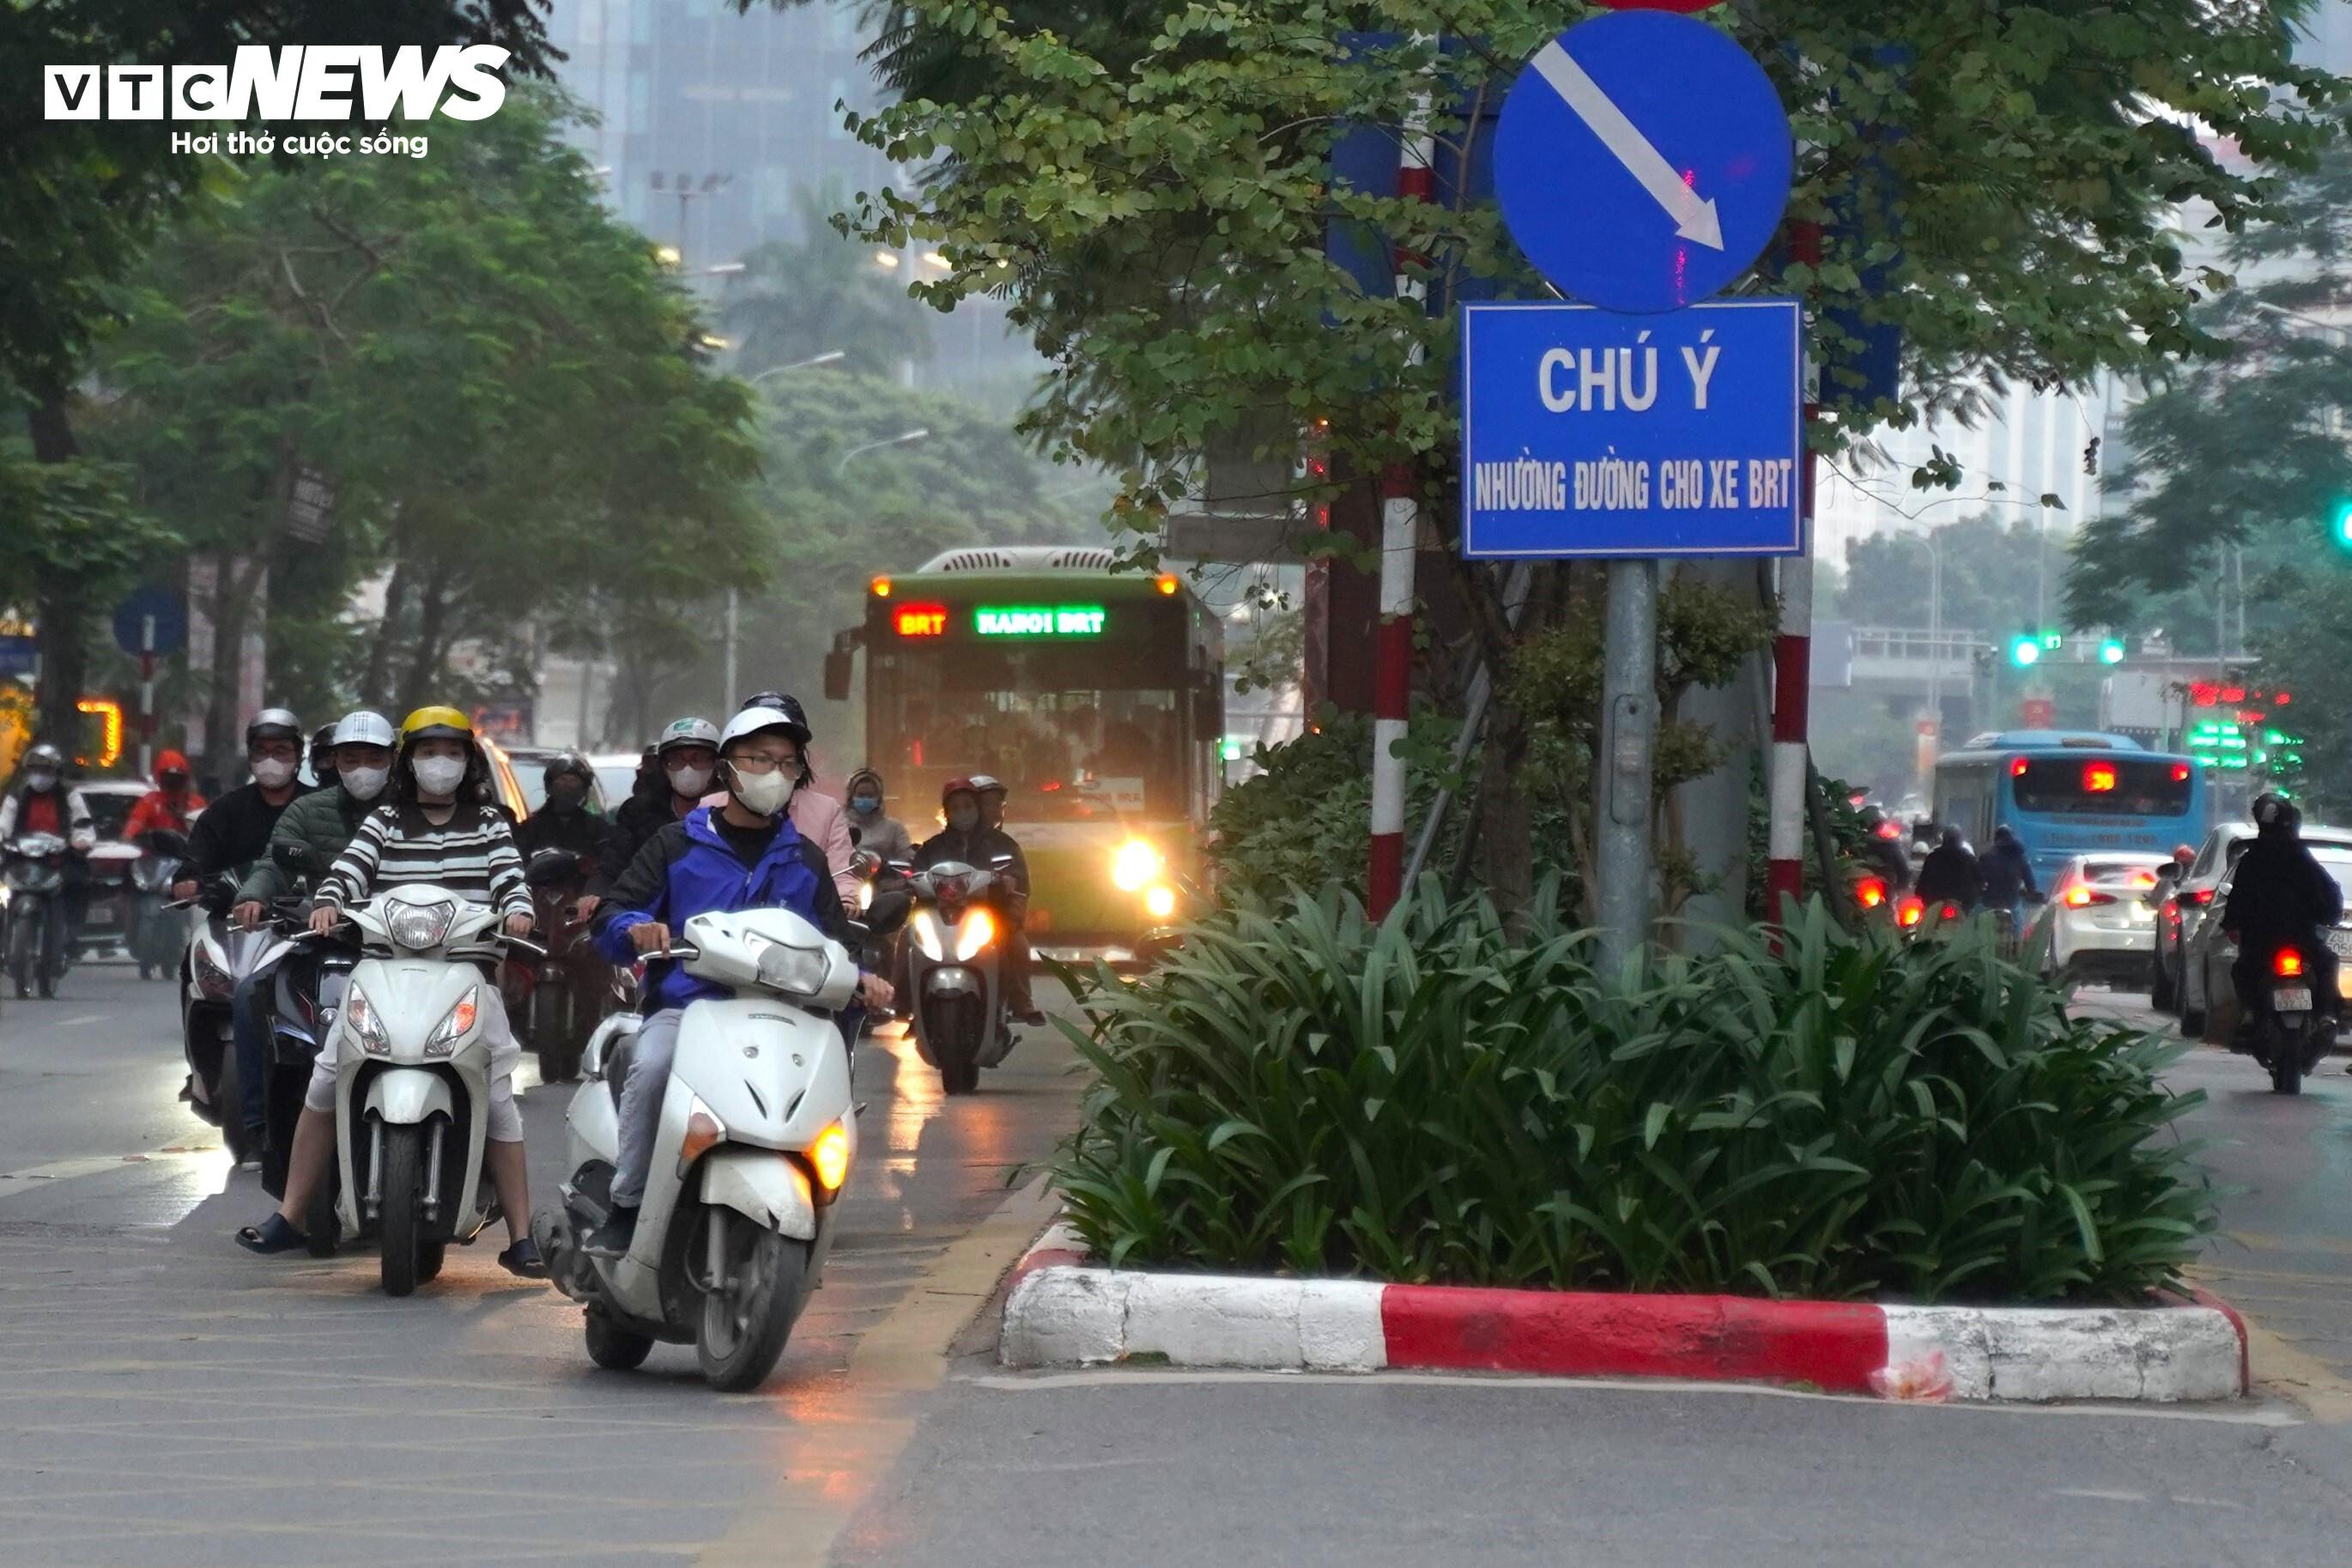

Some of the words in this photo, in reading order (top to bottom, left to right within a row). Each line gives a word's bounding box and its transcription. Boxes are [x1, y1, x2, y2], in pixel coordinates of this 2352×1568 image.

[1539, 330, 1658, 413] CHÚ
[1681, 329, 1721, 410] Ý
[1475, 446, 1567, 512] NHƯỜNG
[1574, 445, 1650, 511] ĐƯỜNG
[1660, 459, 1704, 510] CHO
[1709, 459, 1739, 509] XE
[1749, 458, 1792, 509] BRT
[900, 614, 946, 635] BRT
[1057, 611, 1105, 633] BRT
